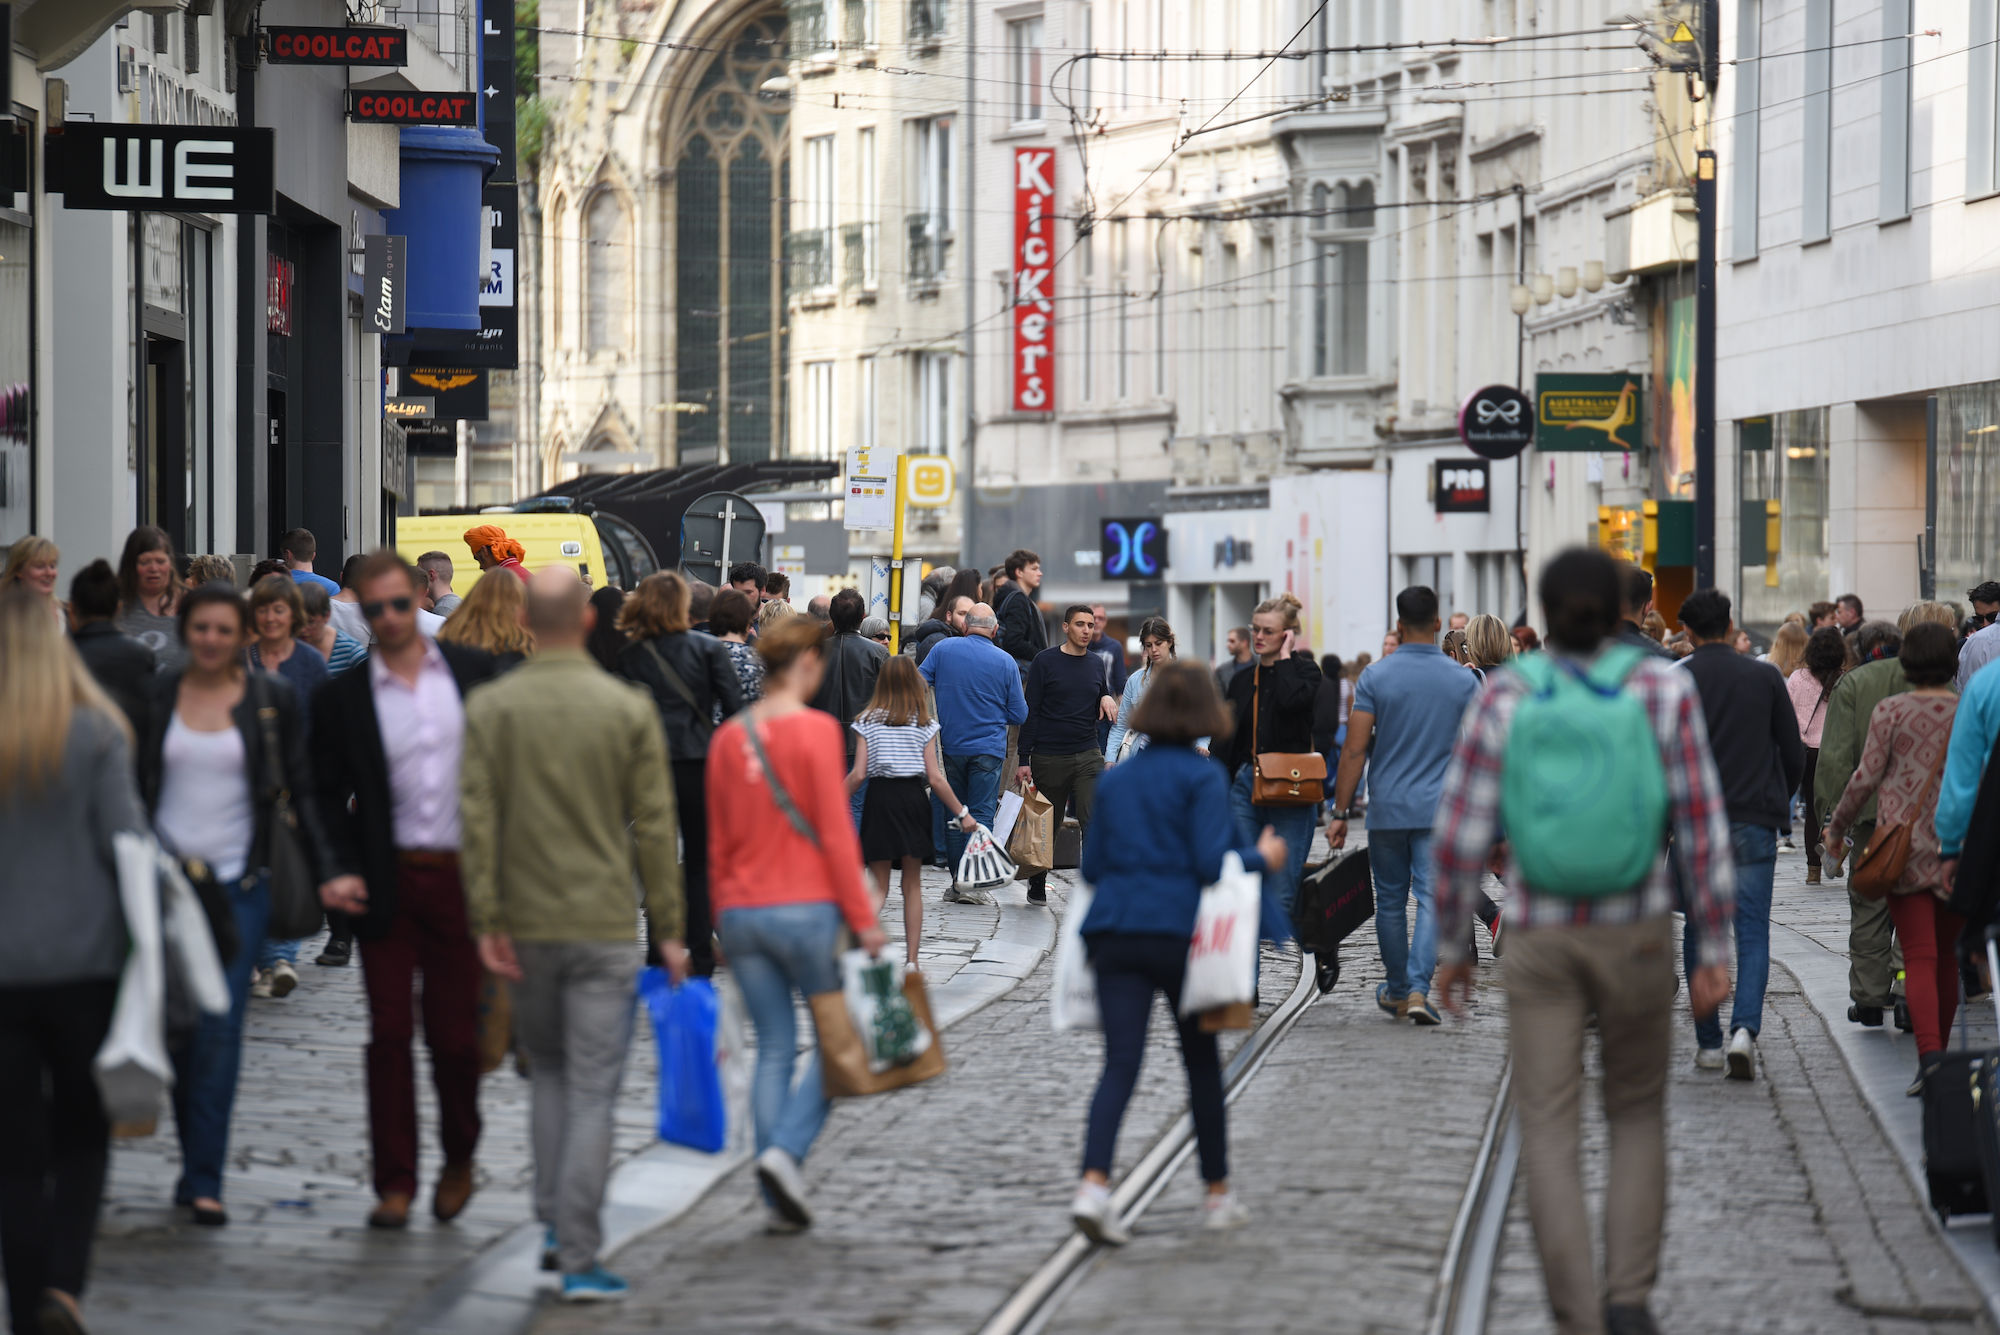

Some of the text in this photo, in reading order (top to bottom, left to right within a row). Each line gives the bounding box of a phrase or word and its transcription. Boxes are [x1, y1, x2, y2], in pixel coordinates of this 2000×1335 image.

[103, 137, 234, 200] WE
[374, 276, 392, 332] Etam
[1442, 468, 1485, 490] PRO
